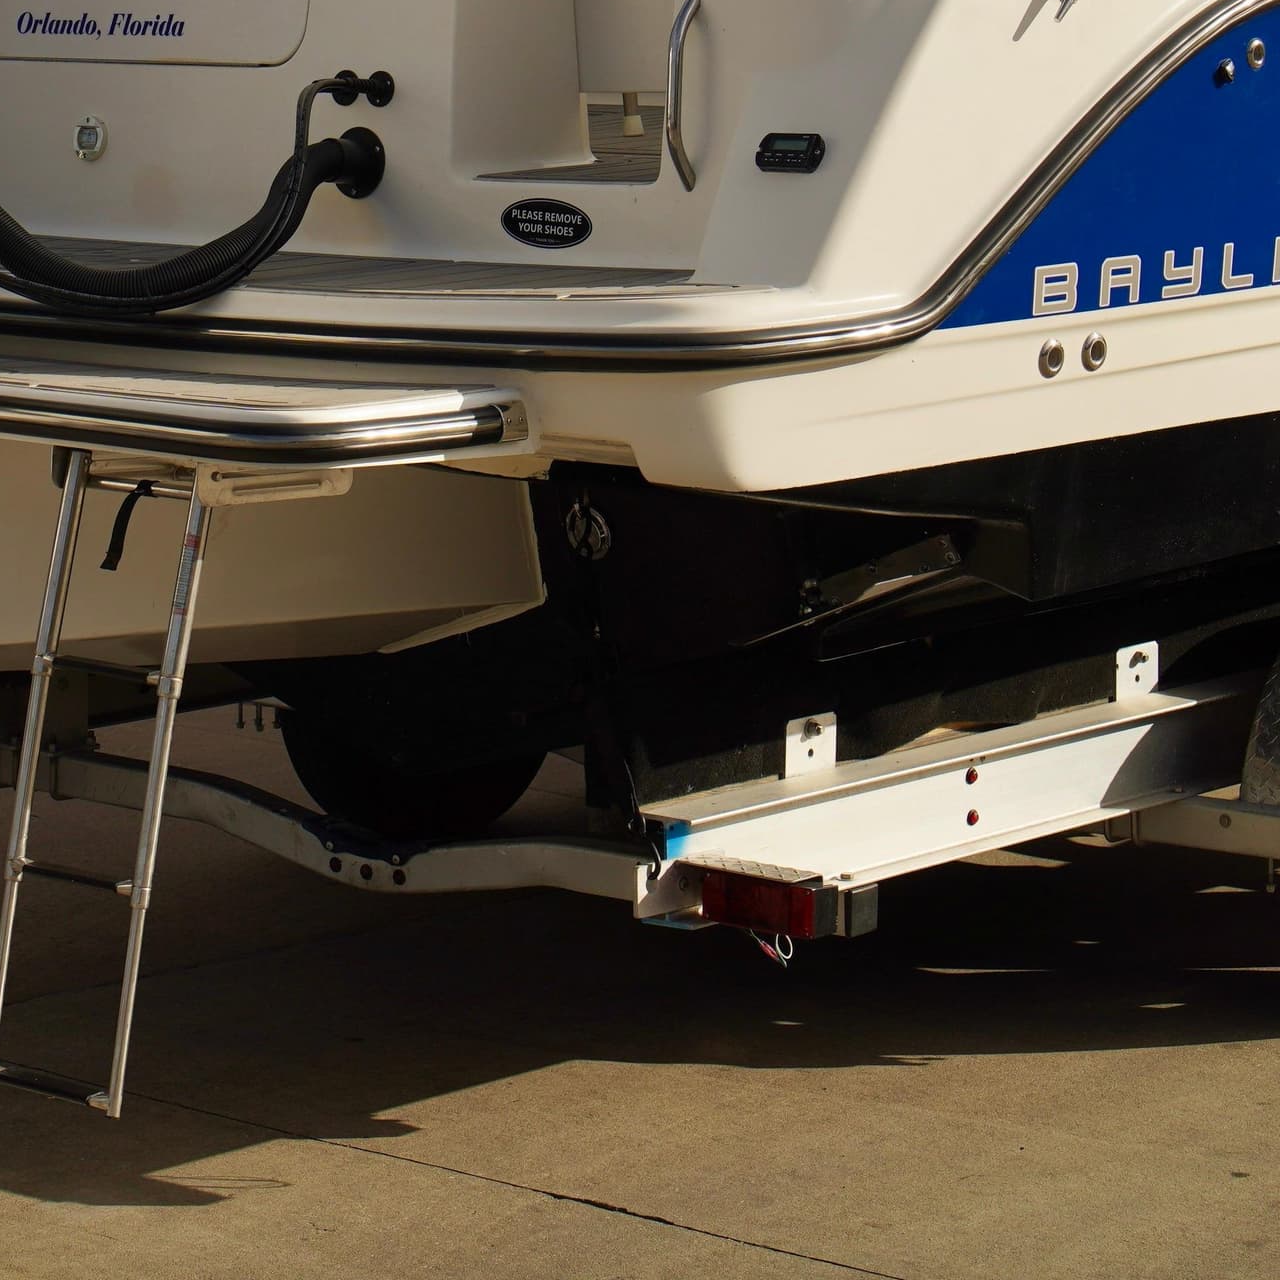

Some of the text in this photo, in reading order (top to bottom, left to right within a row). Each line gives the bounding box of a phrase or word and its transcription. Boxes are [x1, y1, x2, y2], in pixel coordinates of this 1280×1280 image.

[17, 11, 185, 40] Orlando, Florida
[511, 208, 582, 225] PLEASE REMOVE
[518, 222, 574, 237] YOUR SHOES
